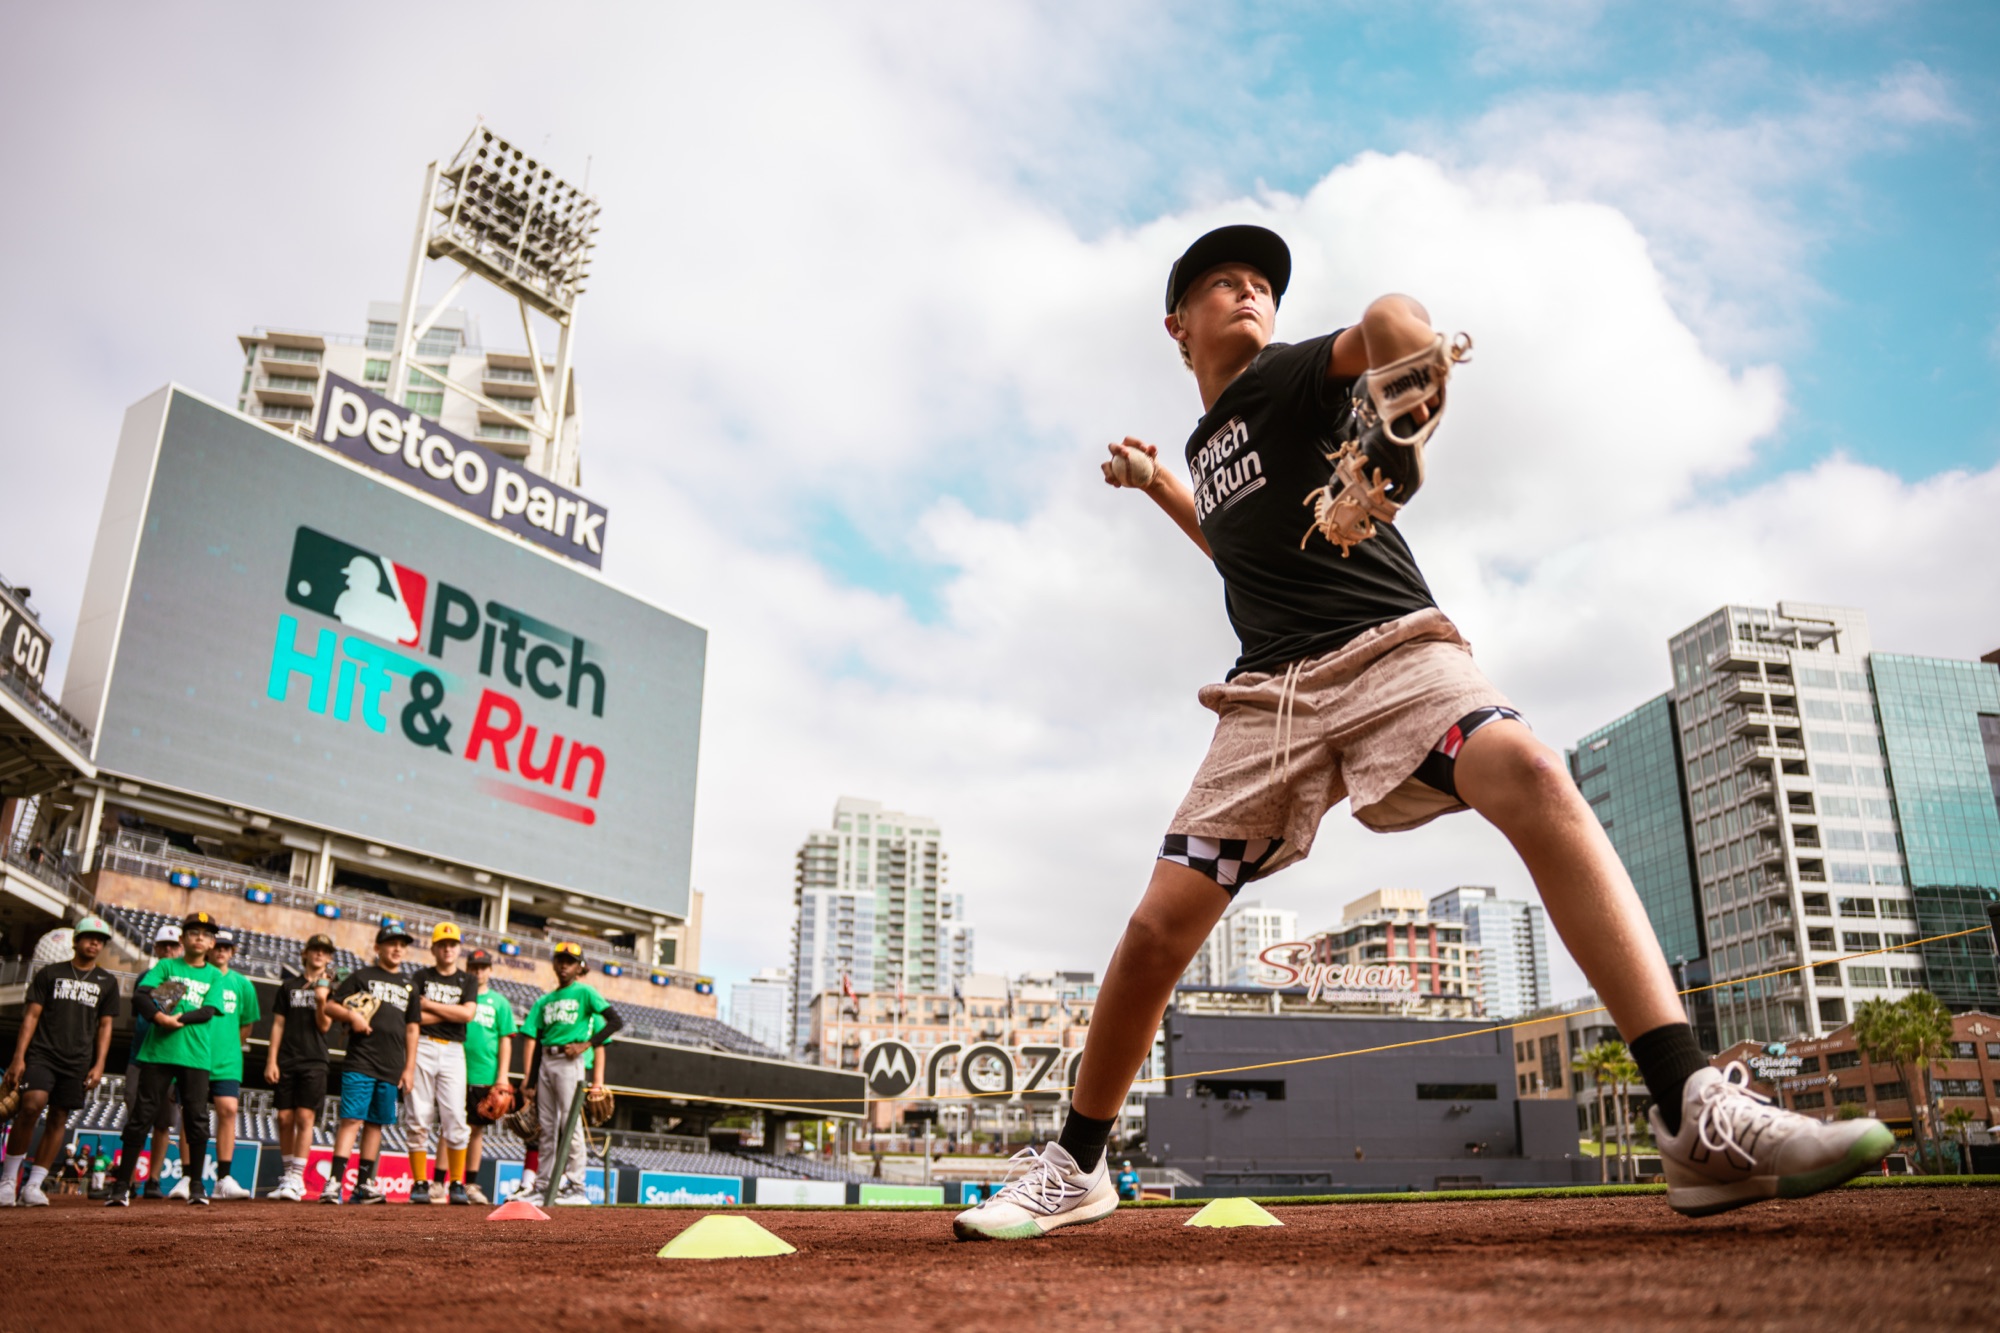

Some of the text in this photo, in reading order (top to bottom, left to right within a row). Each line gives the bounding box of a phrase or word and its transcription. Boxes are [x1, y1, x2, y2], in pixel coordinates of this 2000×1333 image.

[323, 385, 605, 554] petco park
[1198, 419, 1249, 480] Pitch
[1202, 483, 1217, 514] &
[1214, 451, 1262, 503] Run
[13, 623, 44, 684] CO.
[428, 581, 606, 718] Pitch
[267, 613, 606, 799] Hit & Run
[1254, 941, 1415, 1002] Sycuan
[1750, 1057, 1803, 1069] Gallagher
[1759, 1067, 1797, 1079] Square
